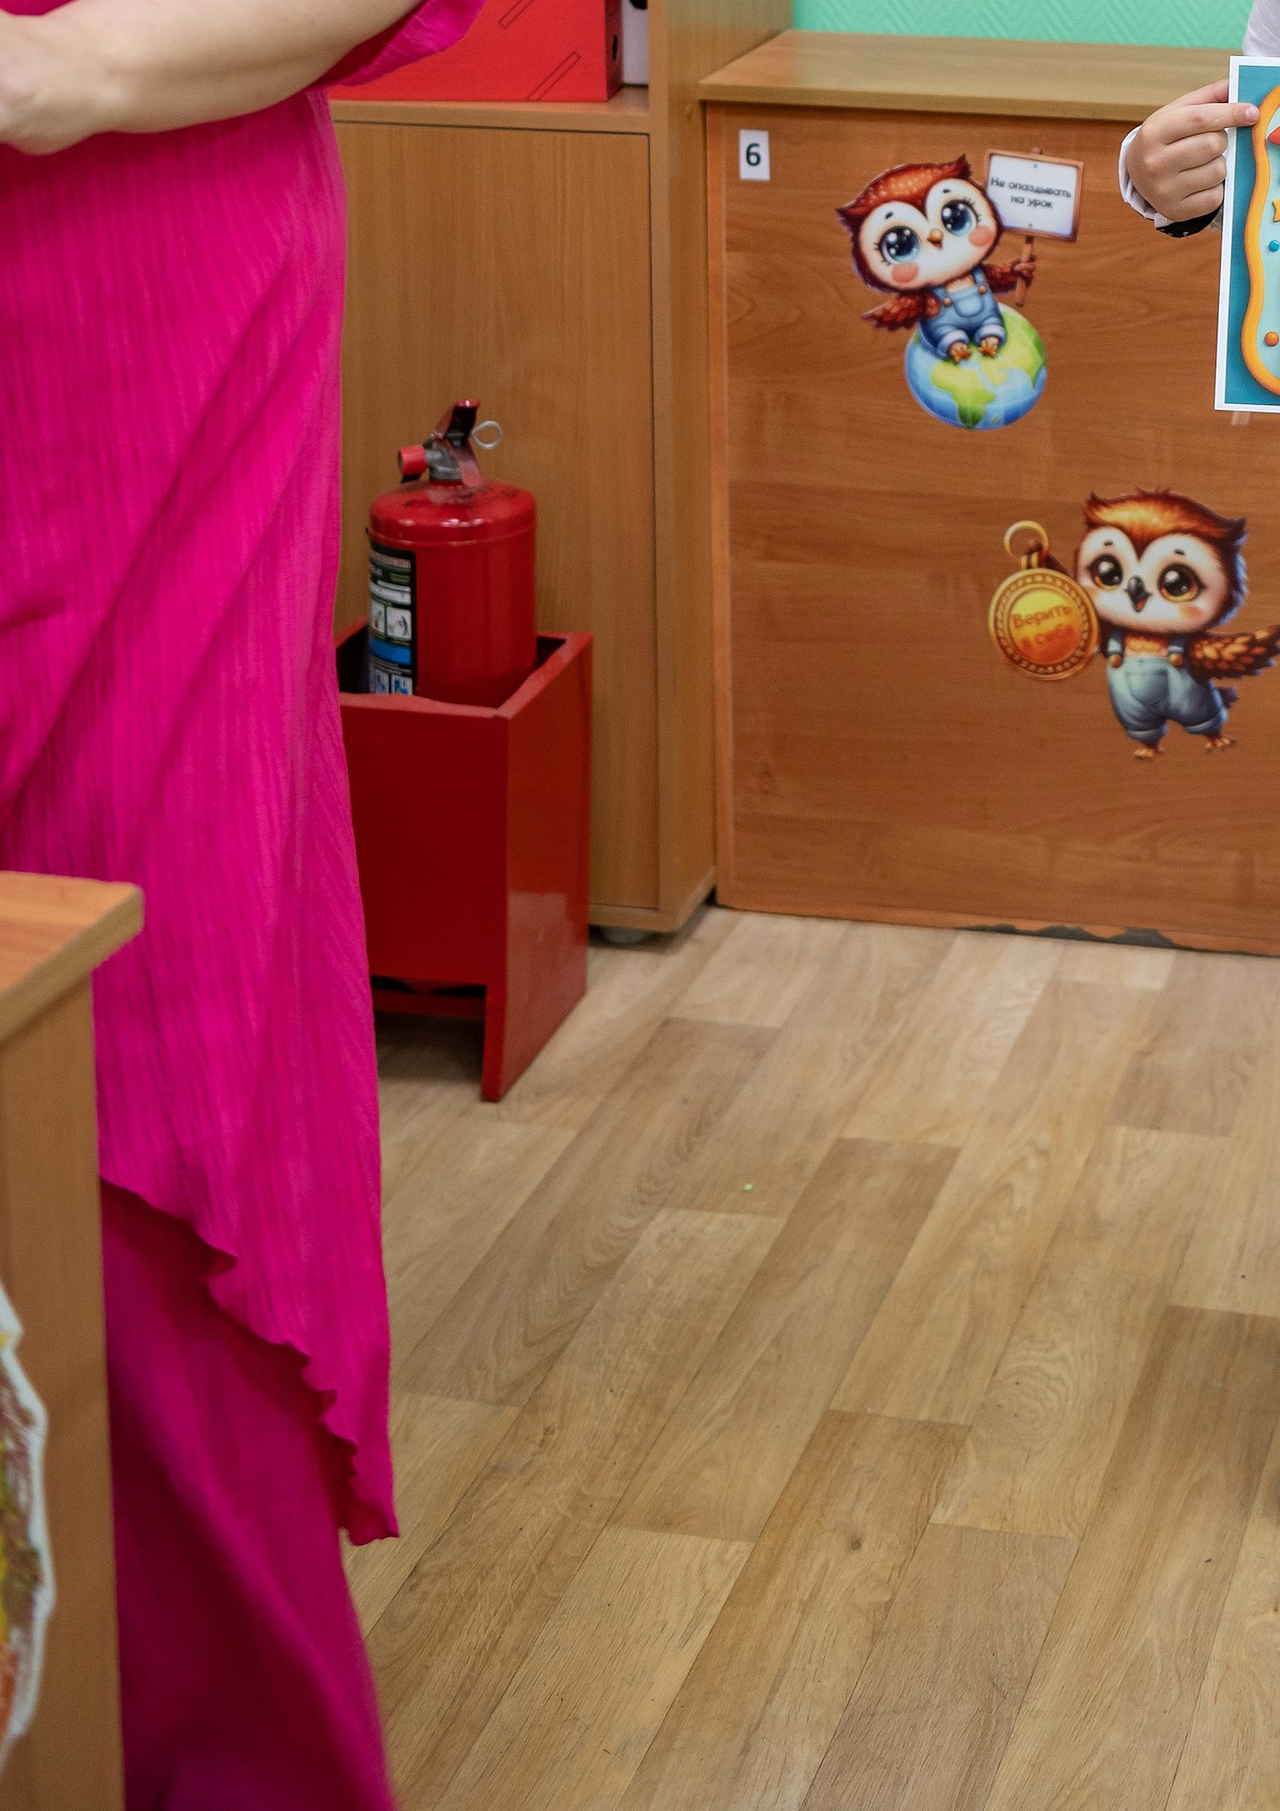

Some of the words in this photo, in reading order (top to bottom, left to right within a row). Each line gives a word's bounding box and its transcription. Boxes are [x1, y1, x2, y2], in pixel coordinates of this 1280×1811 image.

[745, 142, 762, 167] 6
[990, 177, 1006, 189] Не
[1011, 195, 1025, 205] на
[1027, 197, 1053, 209] урок
